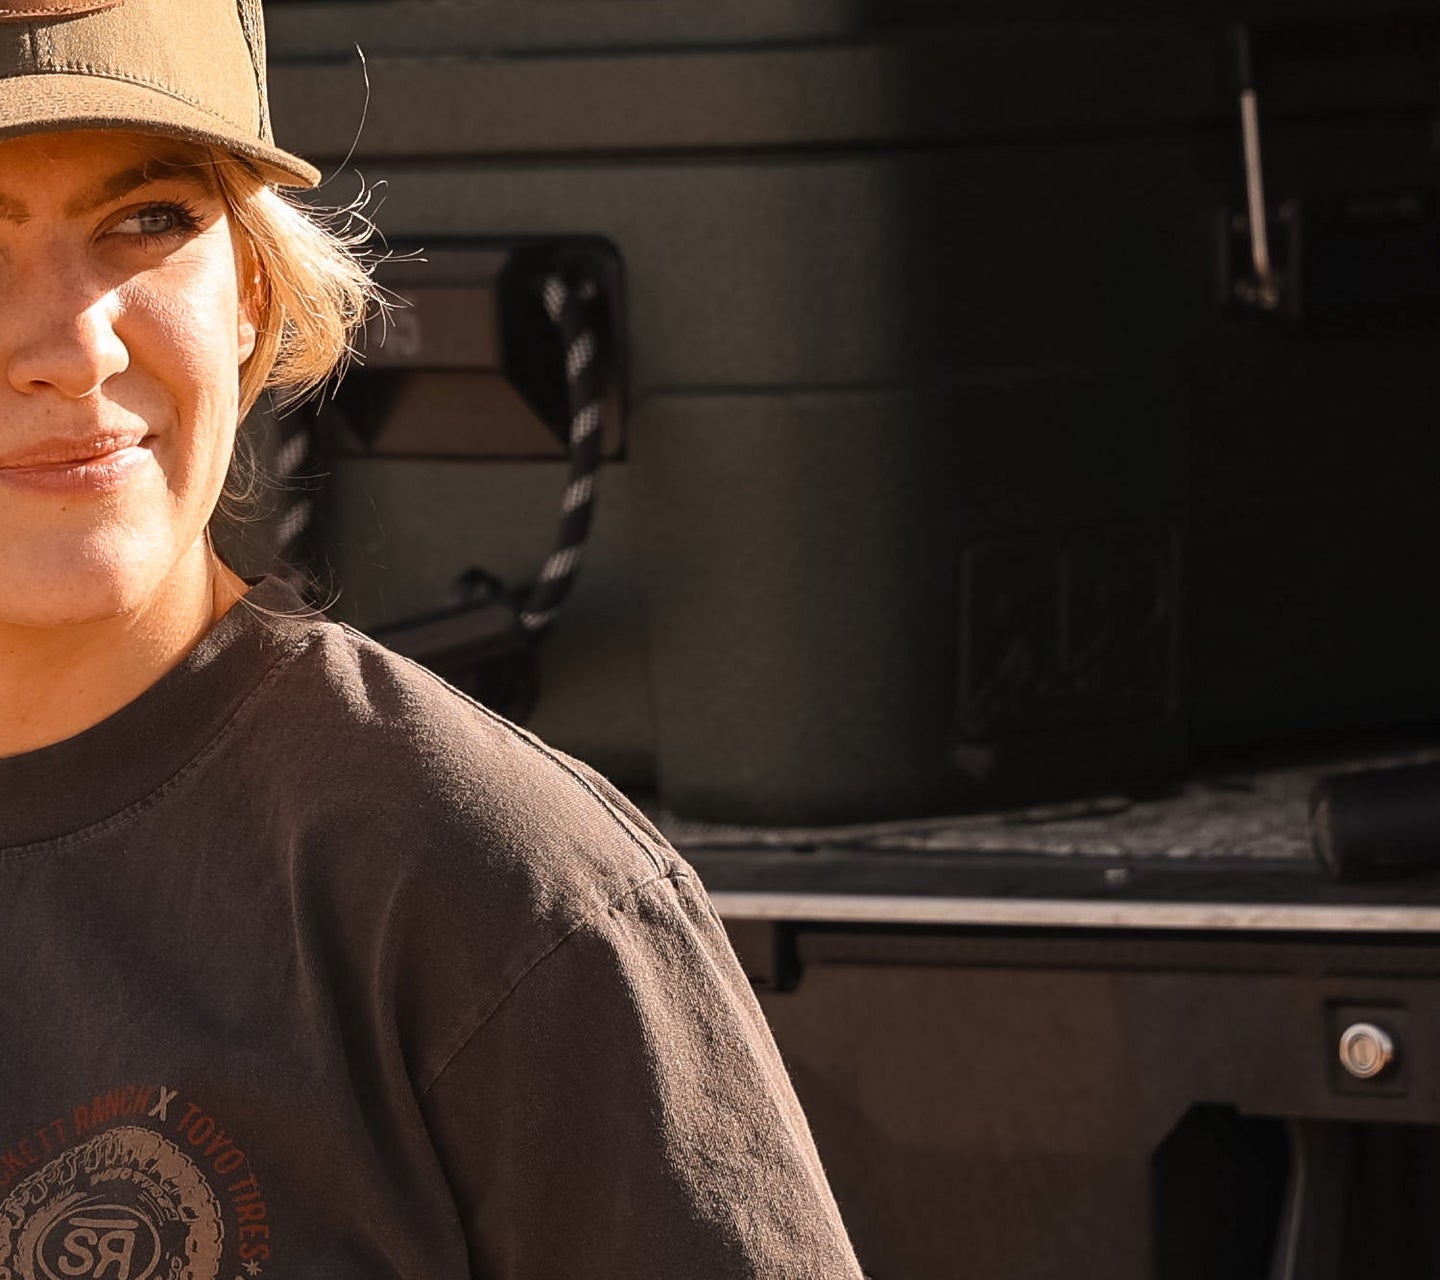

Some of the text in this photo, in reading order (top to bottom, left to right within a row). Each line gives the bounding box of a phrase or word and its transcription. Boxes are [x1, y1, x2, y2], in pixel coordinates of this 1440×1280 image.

[147, 1085, 178, 1121] X
[176, 1102, 245, 1175] TOYO
[227, 1172, 270, 1260] TIRES
